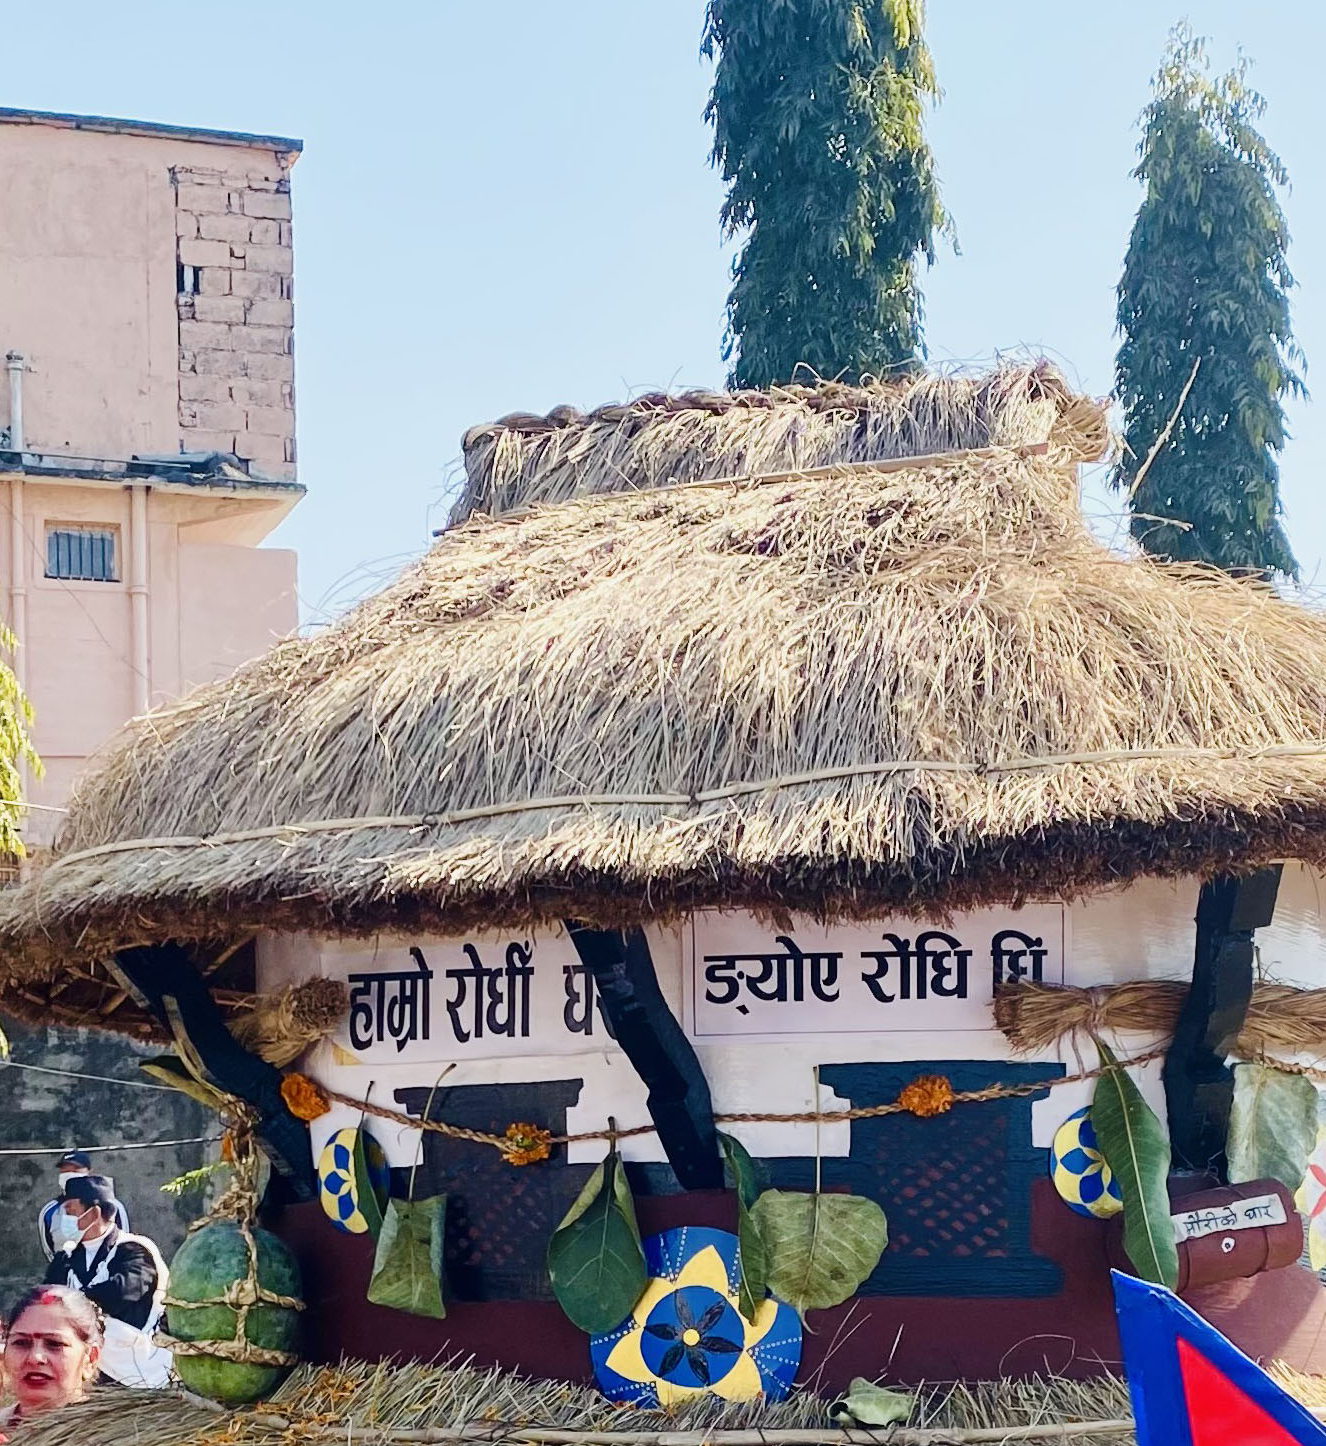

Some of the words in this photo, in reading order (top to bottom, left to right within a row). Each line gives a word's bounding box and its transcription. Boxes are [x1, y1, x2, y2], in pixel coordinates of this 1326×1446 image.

[348, 946, 434, 1053] हाम्रो
[563, 964, 617, 1040] घ
[860, 930, 973, 1004] रोंधि
